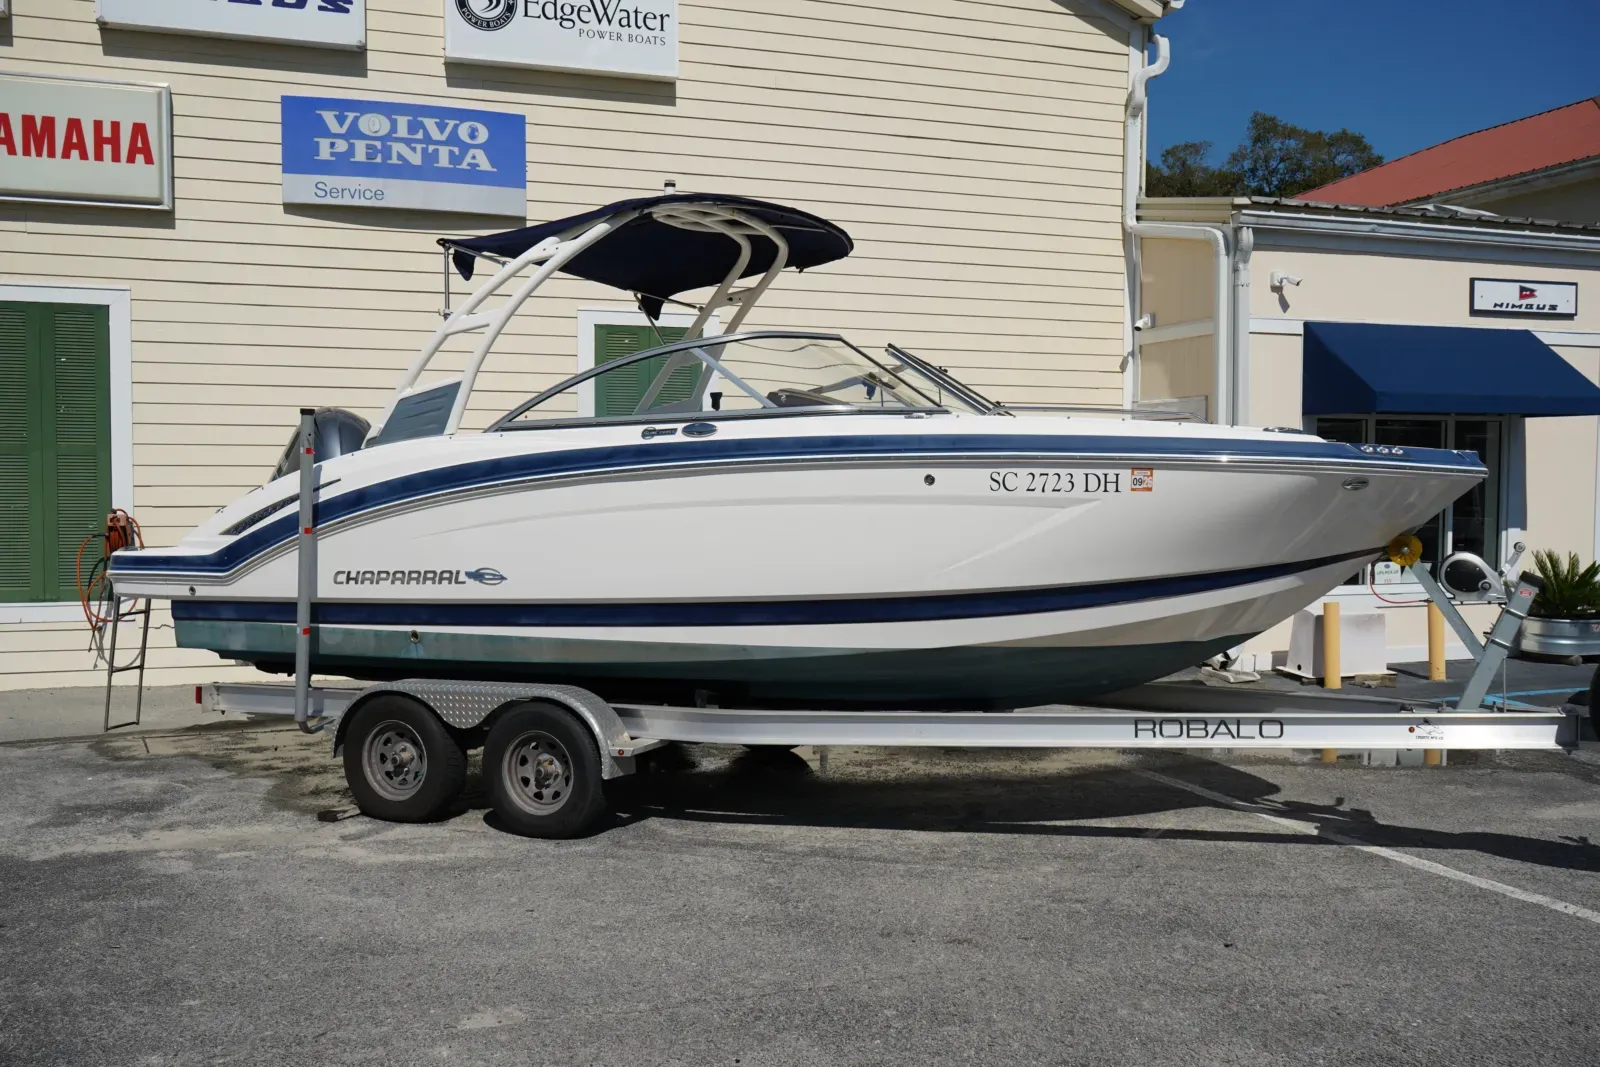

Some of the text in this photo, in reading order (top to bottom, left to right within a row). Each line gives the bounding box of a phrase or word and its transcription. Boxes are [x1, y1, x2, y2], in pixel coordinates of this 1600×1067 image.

[461, 7, 512, 28] POWER BOATS
[578, 28, 666, 46] POWER BOATS
[315, 110, 489, 145] VOLVO
[314, 137, 497, 172] PENTA
[314, 181, 385, 201] Service
[1492, 302, 1558, 311] NIMBUS
[989, 471, 1121, 493] SC 2723 DH
[1132, 477, 1143, 486] 09
[333, 569, 466, 585] CHAPARRAL
[1134, 719, 1284, 739] ROBALO
